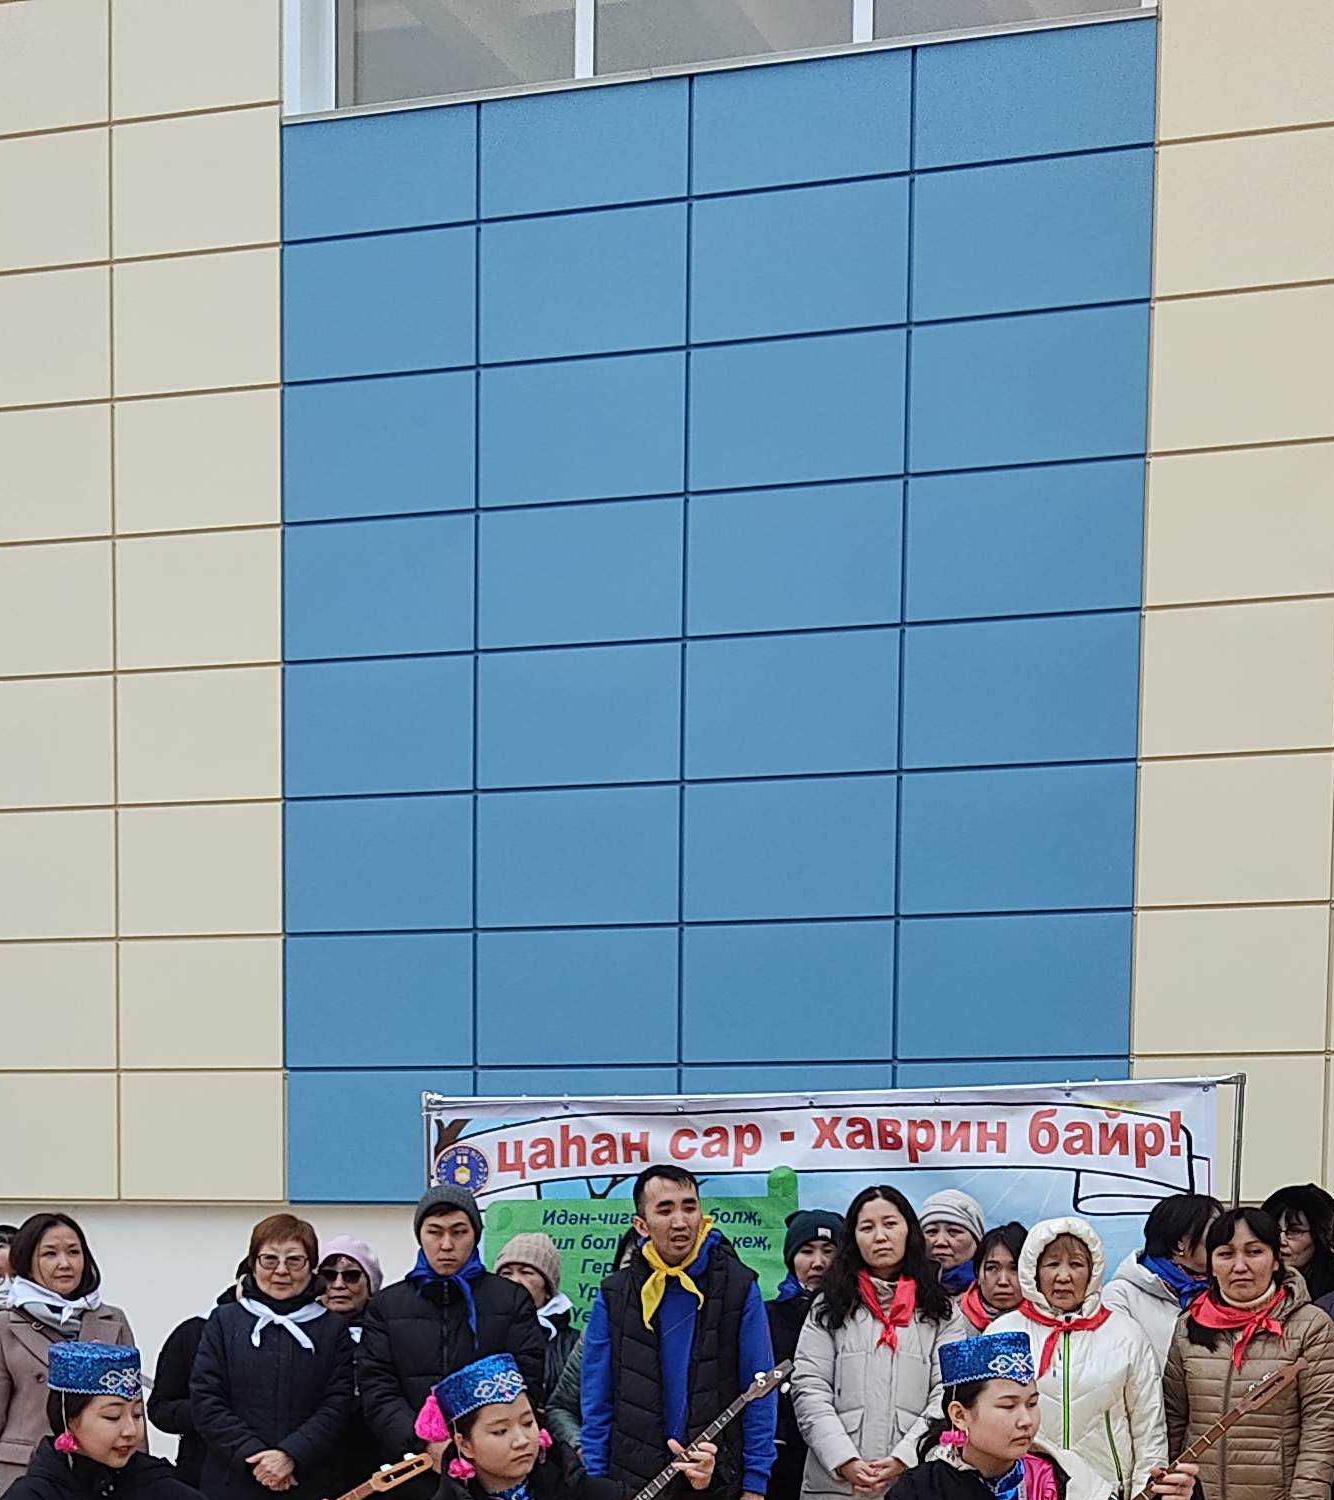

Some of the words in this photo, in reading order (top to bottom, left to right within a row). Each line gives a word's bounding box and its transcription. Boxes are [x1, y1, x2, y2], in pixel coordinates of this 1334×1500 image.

[669, 1122, 763, 1168] сар
[779, 1130, 796, 1142] -
[811, 1114, 1008, 1164] хаврин
[1027, 1108, 1182, 1169] байр!
[580, 1258, 615, 1278] Гер
